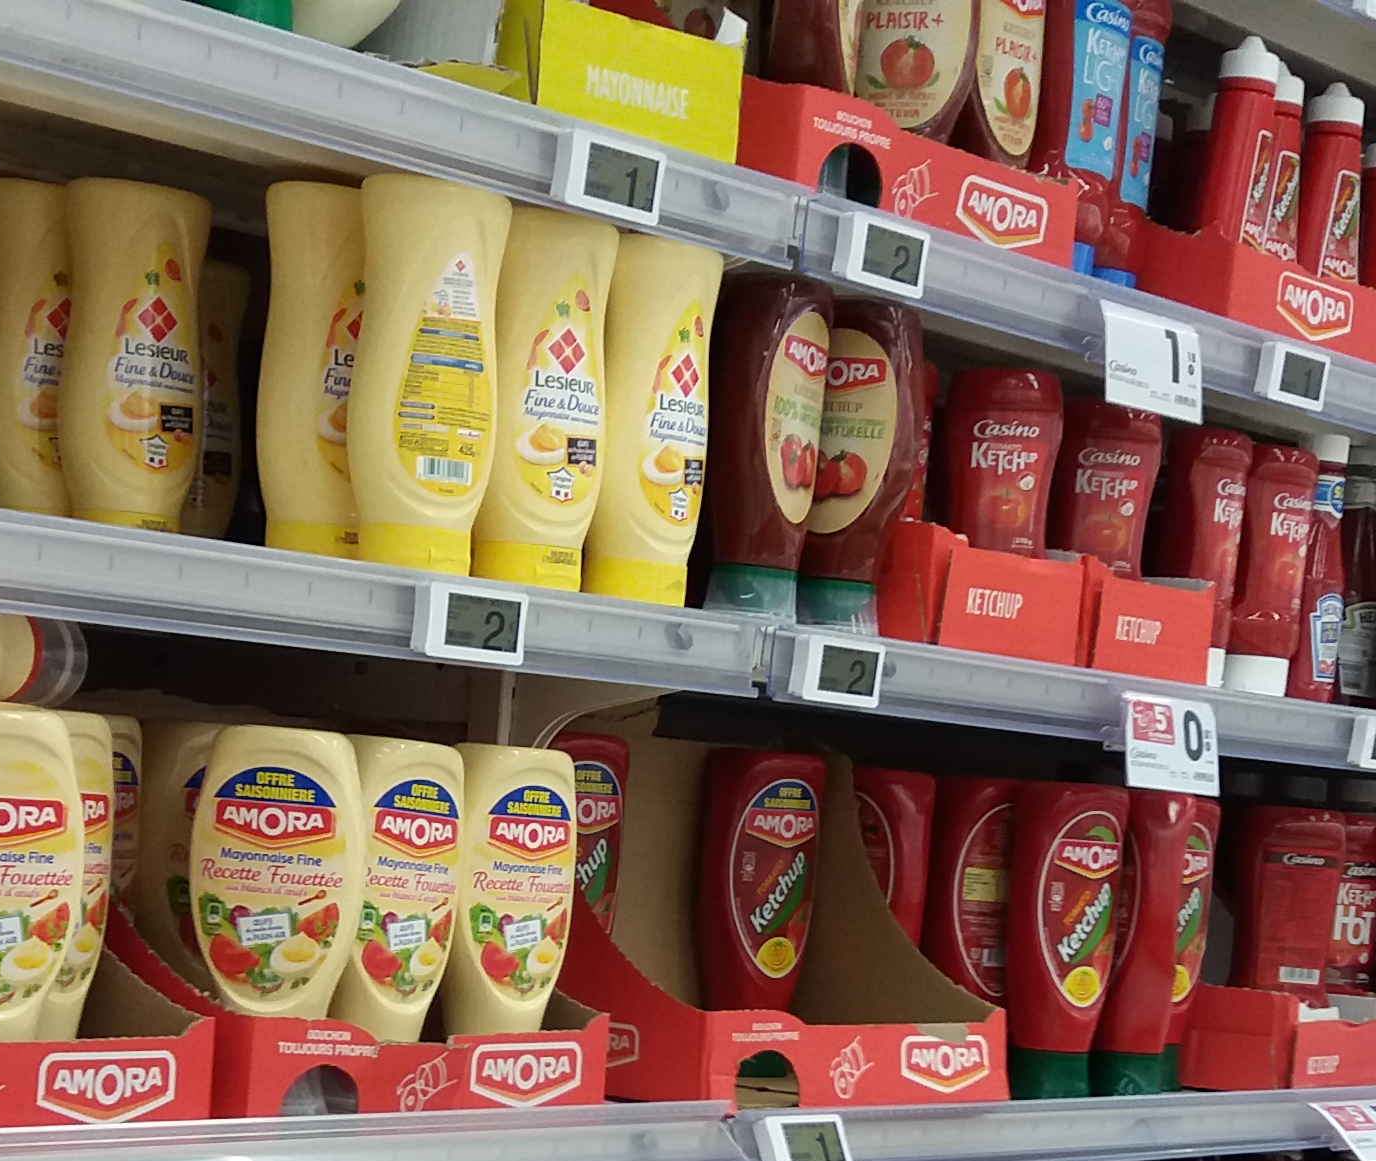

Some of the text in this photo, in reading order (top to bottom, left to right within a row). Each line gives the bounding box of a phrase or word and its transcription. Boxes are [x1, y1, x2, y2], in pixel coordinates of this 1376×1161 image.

[586, 65, 690, 121] MAYONNAISE
[813, 117, 892, 149] TOUJOURS PROPRE
[625, 169, 638, 208] 1
[968, 191, 1038, 230] AMORA
[890, 245, 909, 282] 2
[1285, 286, 1346, 323] AMORA
[114, 357, 147, 377] Fine
[160, 362, 195, 384] Douce
[1164, 329, 1180, 384] 1
[525, 389, 554, 408] Fine
[567, 394, 599, 415] Douce
[974, 419, 1041, 439] Casino
[970, 442, 1038, 472] KETCHUP
[1078, 447, 1140, 467] Casino
[1075, 470, 1138, 498] KETCHUP
[965, 587, 1024, 618] KETCHUP
[1115, 615, 1162, 644] KETCHUP
[849, 660, 866, 691] 2
[1184, 710, 1203, 761] 0
[256, 771, 295, 786] OFFRE
[410, 784, 439, 800] OFFRE
[523, 790, 551, 805] OFFRE
[380, 816, 454, 845] AMORA
[495, 822, 567, 849] AMORA
[753, 814, 813, 839] AMORA
[29, 850, 54, 864] Fine
[220, 847, 322, 867] Mayonnaise Fine
[377, 856, 450, 875] Mayonnaise Fine
[1282, 852, 1326, 867] Casino
[200, 858, 343, 888] Recette Fouettée
[750, 851, 806, 935] Ketchup
[1057, 882, 1111, 963] Ketchup
[278, 1041, 378, 1058] TOUJOURS PROPRE
[910, 1043, 982, 1071] AMORA
[52, 1064, 163, 1104] AMORA
[482, 1054, 572, 1089] AMORA
